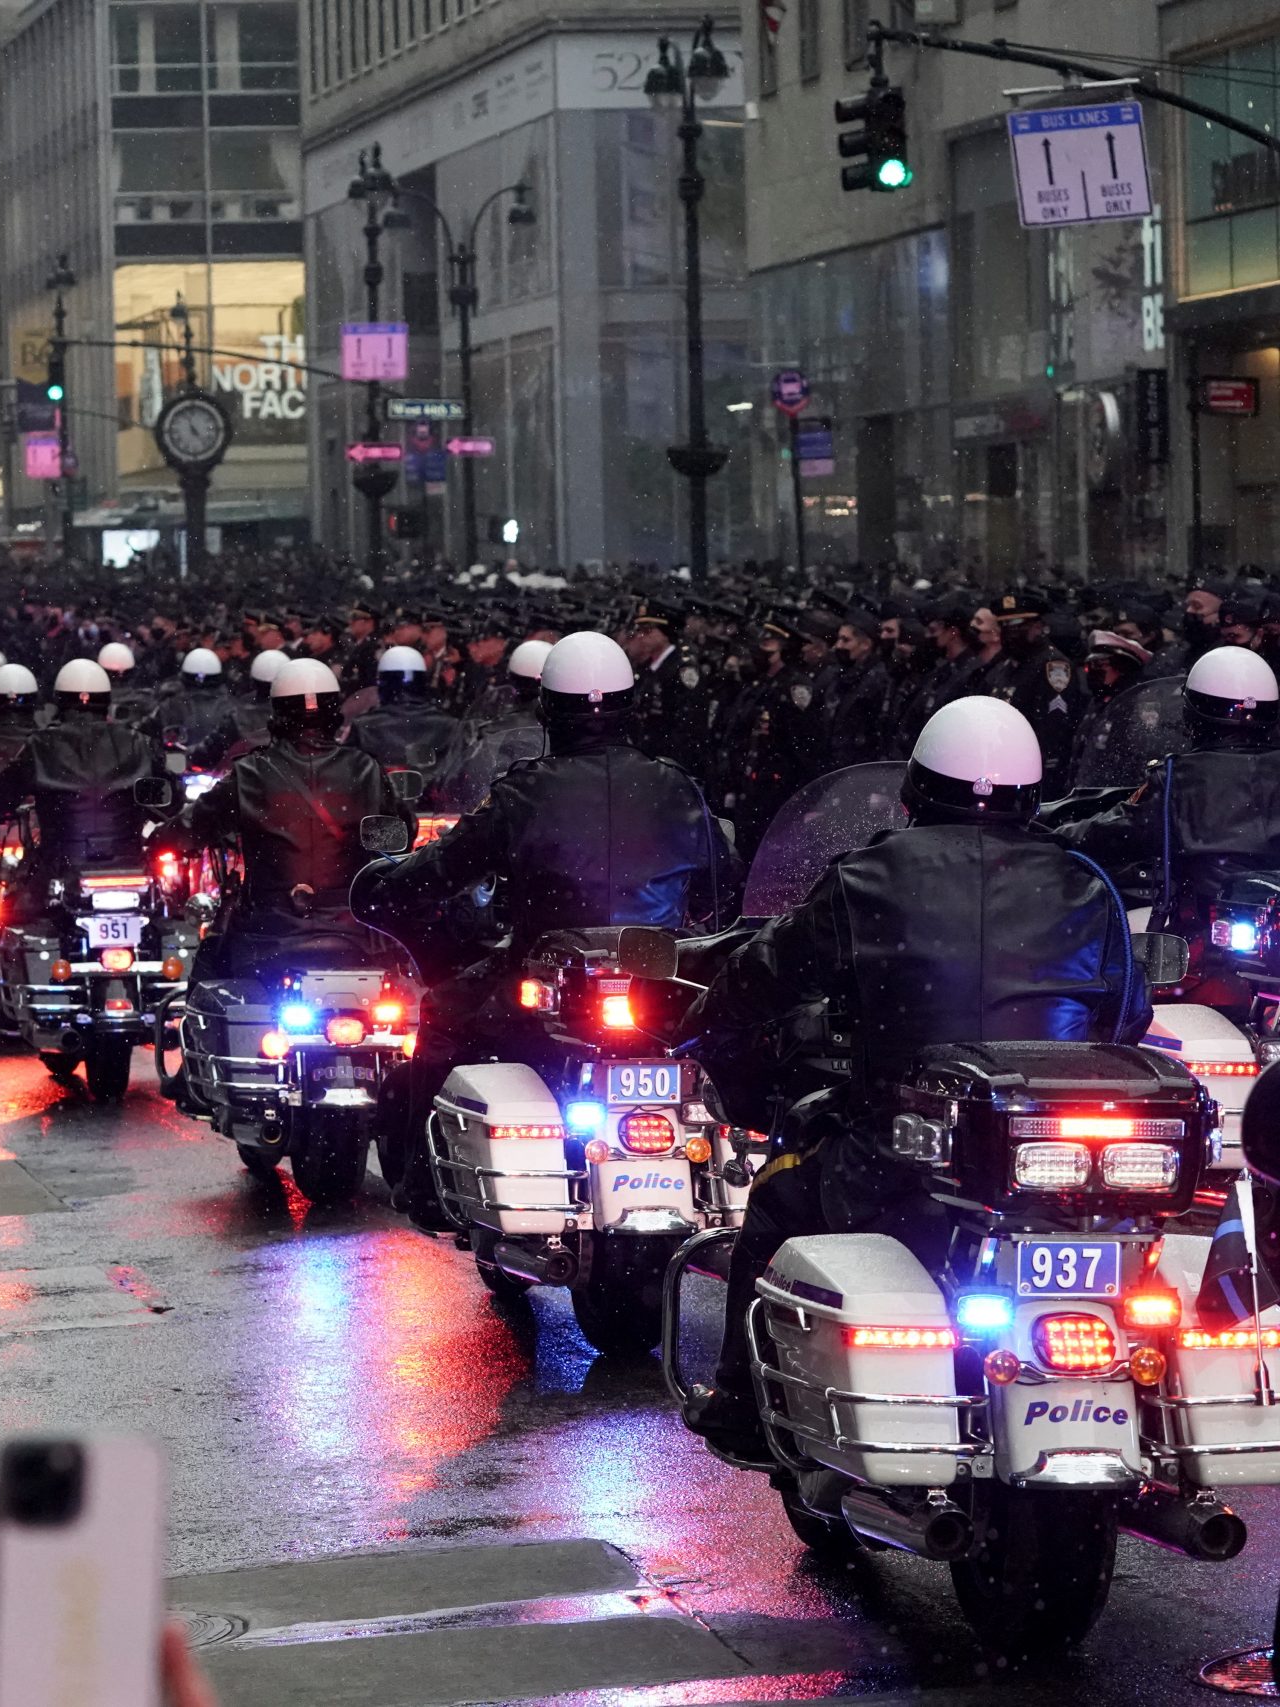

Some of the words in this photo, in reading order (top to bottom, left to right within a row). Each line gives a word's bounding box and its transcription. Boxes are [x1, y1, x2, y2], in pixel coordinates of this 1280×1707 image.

[1040, 114, 1066, 129] BUS
[1070, 110, 1110, 126] LANES
[1037, 188, 1070, 203] BUSES
[1100, 182, 1133, 197] BUSES
[1041, 206, 1069, 219] ONLY
[1105, 199, 1132, 213] ONLY
[260, 334, 306, 361] TH
[242, 390, 306, 419] FAC
[100, 922, 128, 940] 951
[312, 1066, 376, 1082] POLICE
[620, 1067, 670, 1097] 950
[612, 1173, 685, 1192] Police
[1032, 1246, 1102, 1290] 937
[1023, 1399, 1129, 1426] Police
